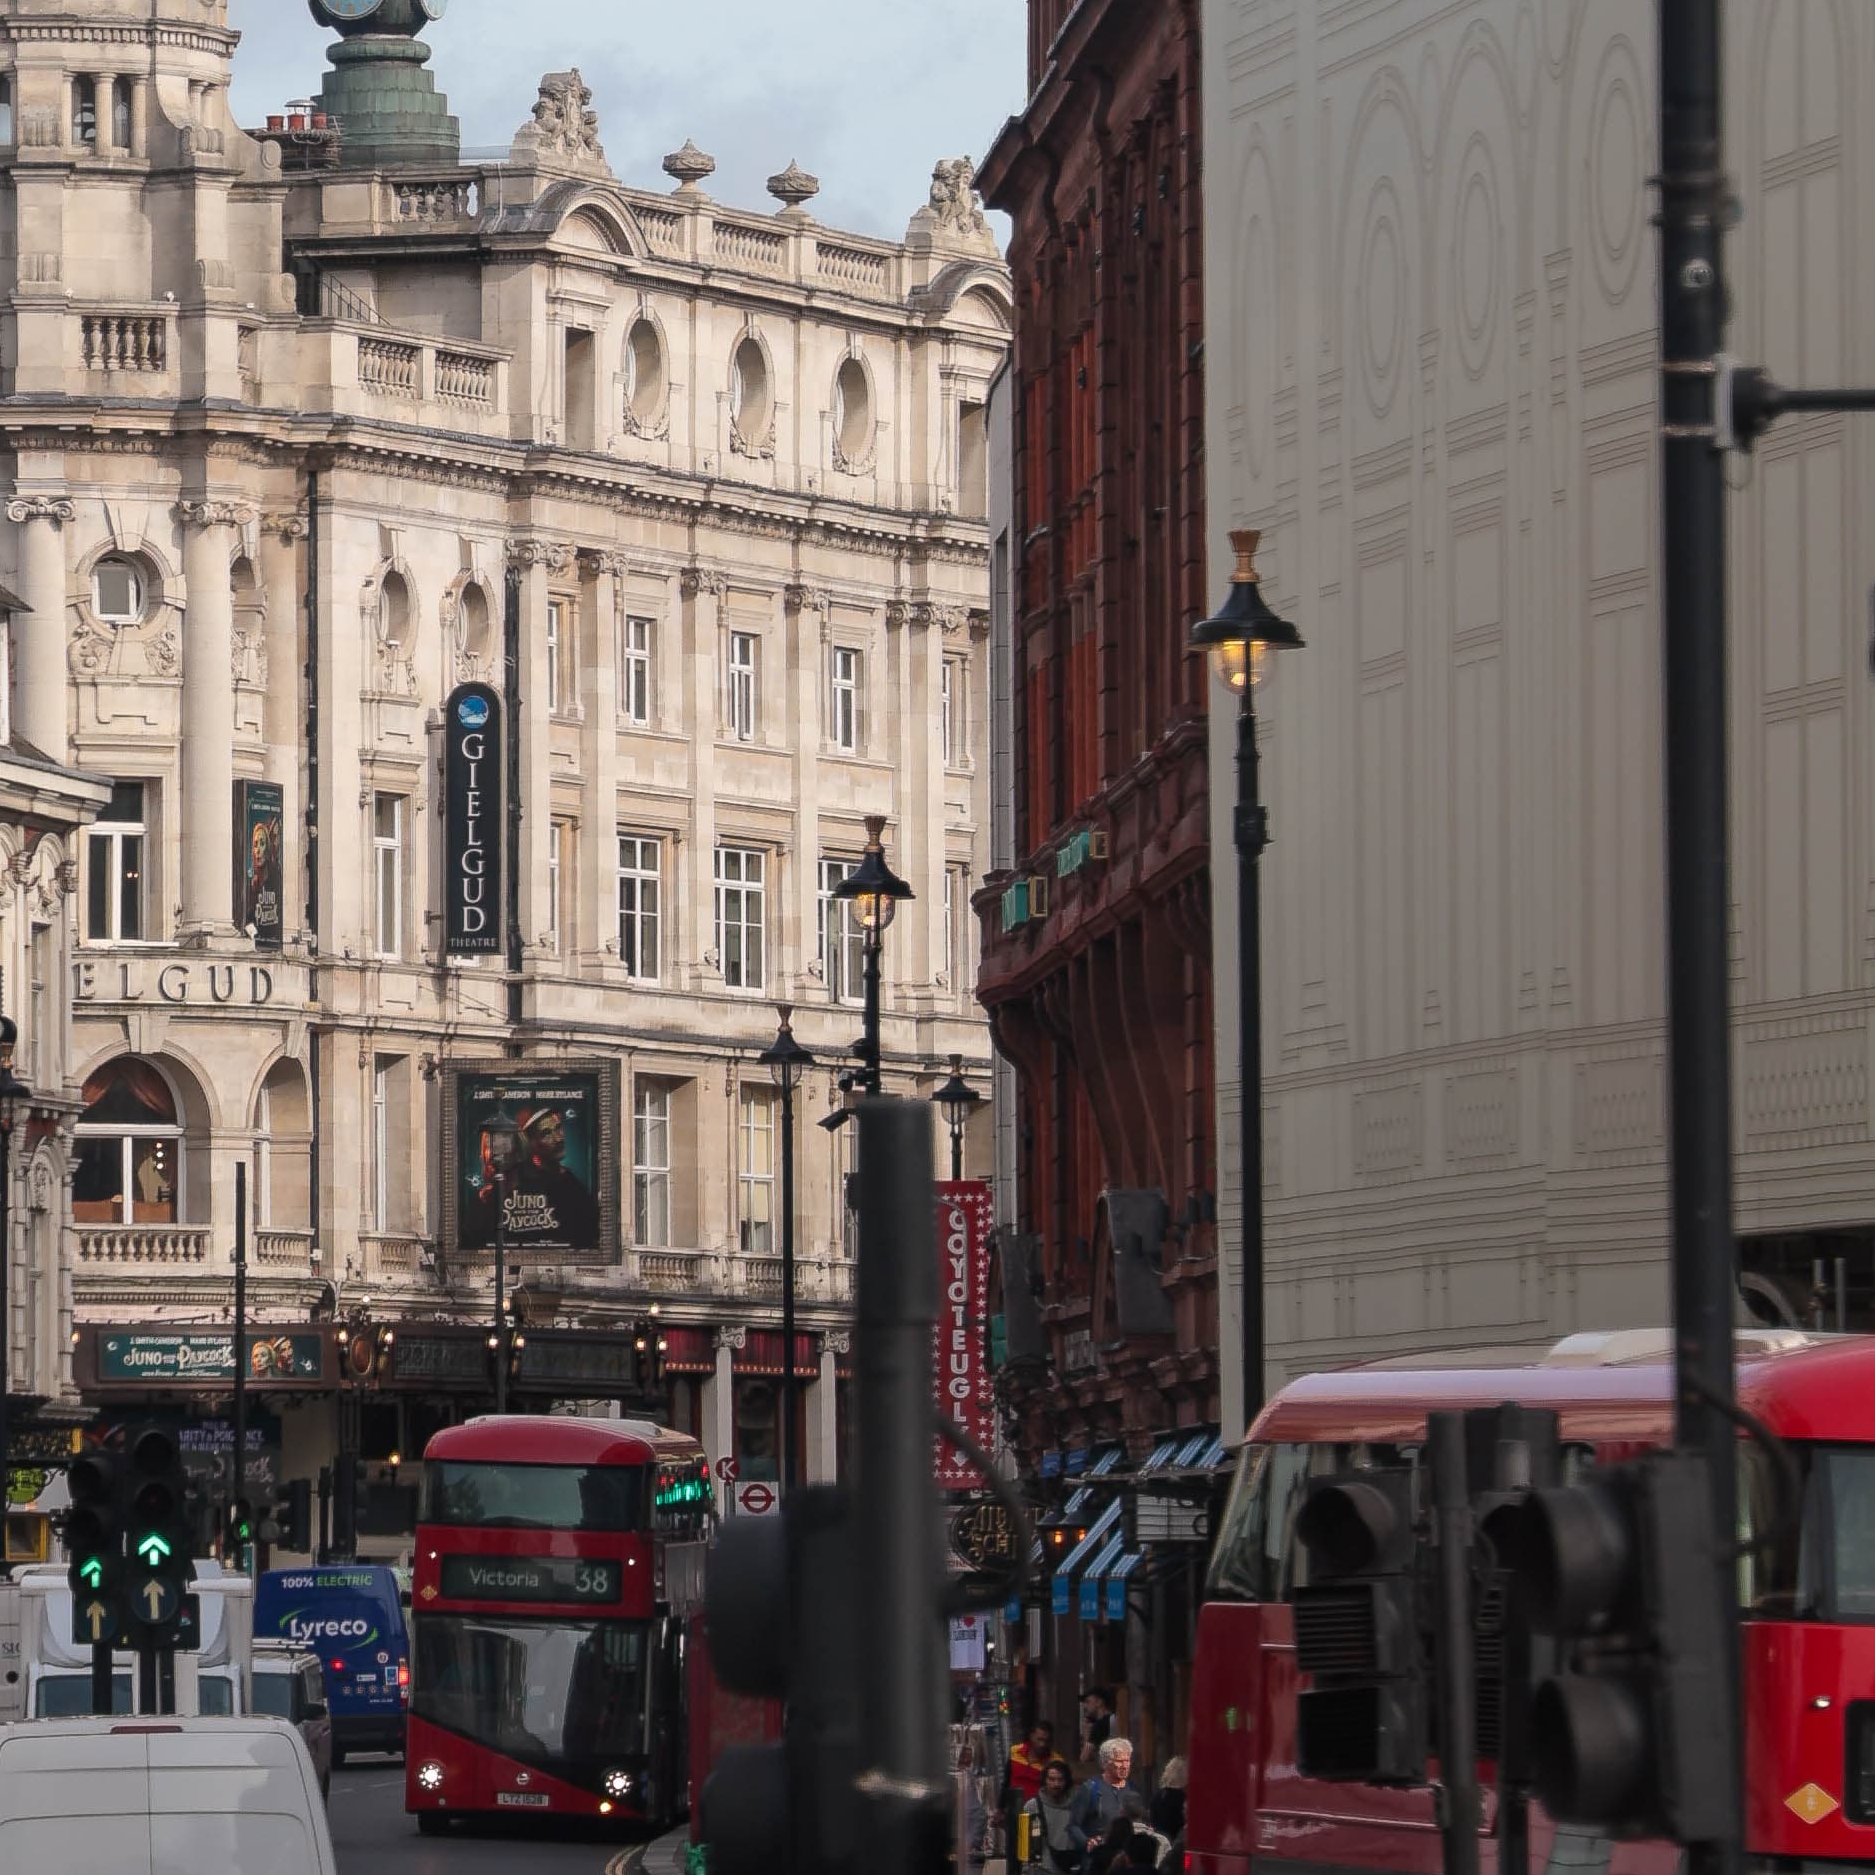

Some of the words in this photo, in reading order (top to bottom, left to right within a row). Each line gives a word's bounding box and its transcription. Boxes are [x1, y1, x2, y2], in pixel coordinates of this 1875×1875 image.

[461, 733, 486, 932] GIELGUD
[451, 937, 497, 948] THEATRE
[504, 1190, 546, 1210] JUNO
[721, 1461, 735, 1478] K
[281, 1576, 314, 1589] 100%
[317, 1574, 373, 1586] ELECTRIC
[469, 1567, 540, 1589] Victoria
[576, 1567, 609, 1594] 38
[290, 1619, 368, 1640] Lyreco
